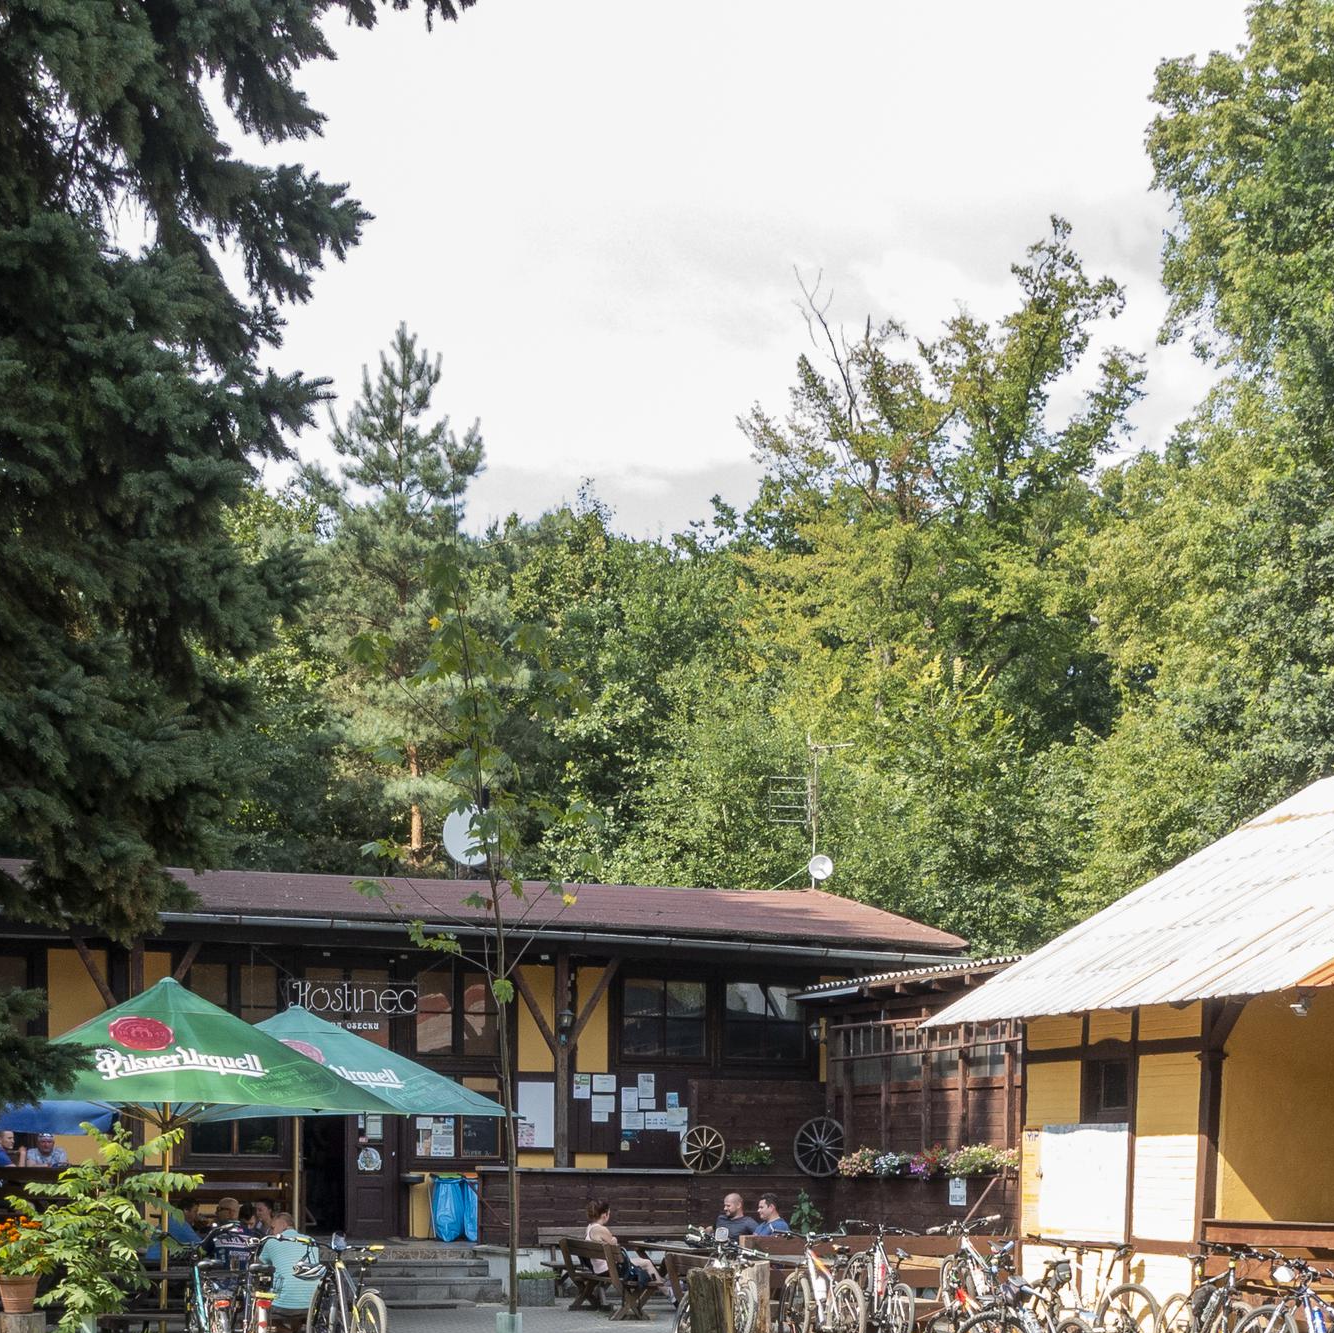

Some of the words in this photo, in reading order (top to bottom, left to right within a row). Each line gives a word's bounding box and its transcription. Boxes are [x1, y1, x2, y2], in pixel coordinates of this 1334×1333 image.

[288, 980, 417, 1013] Hostinec
[95, 1050, 178, 1080] Pilsner
[175, 1047, 264, 1075] Urquell
